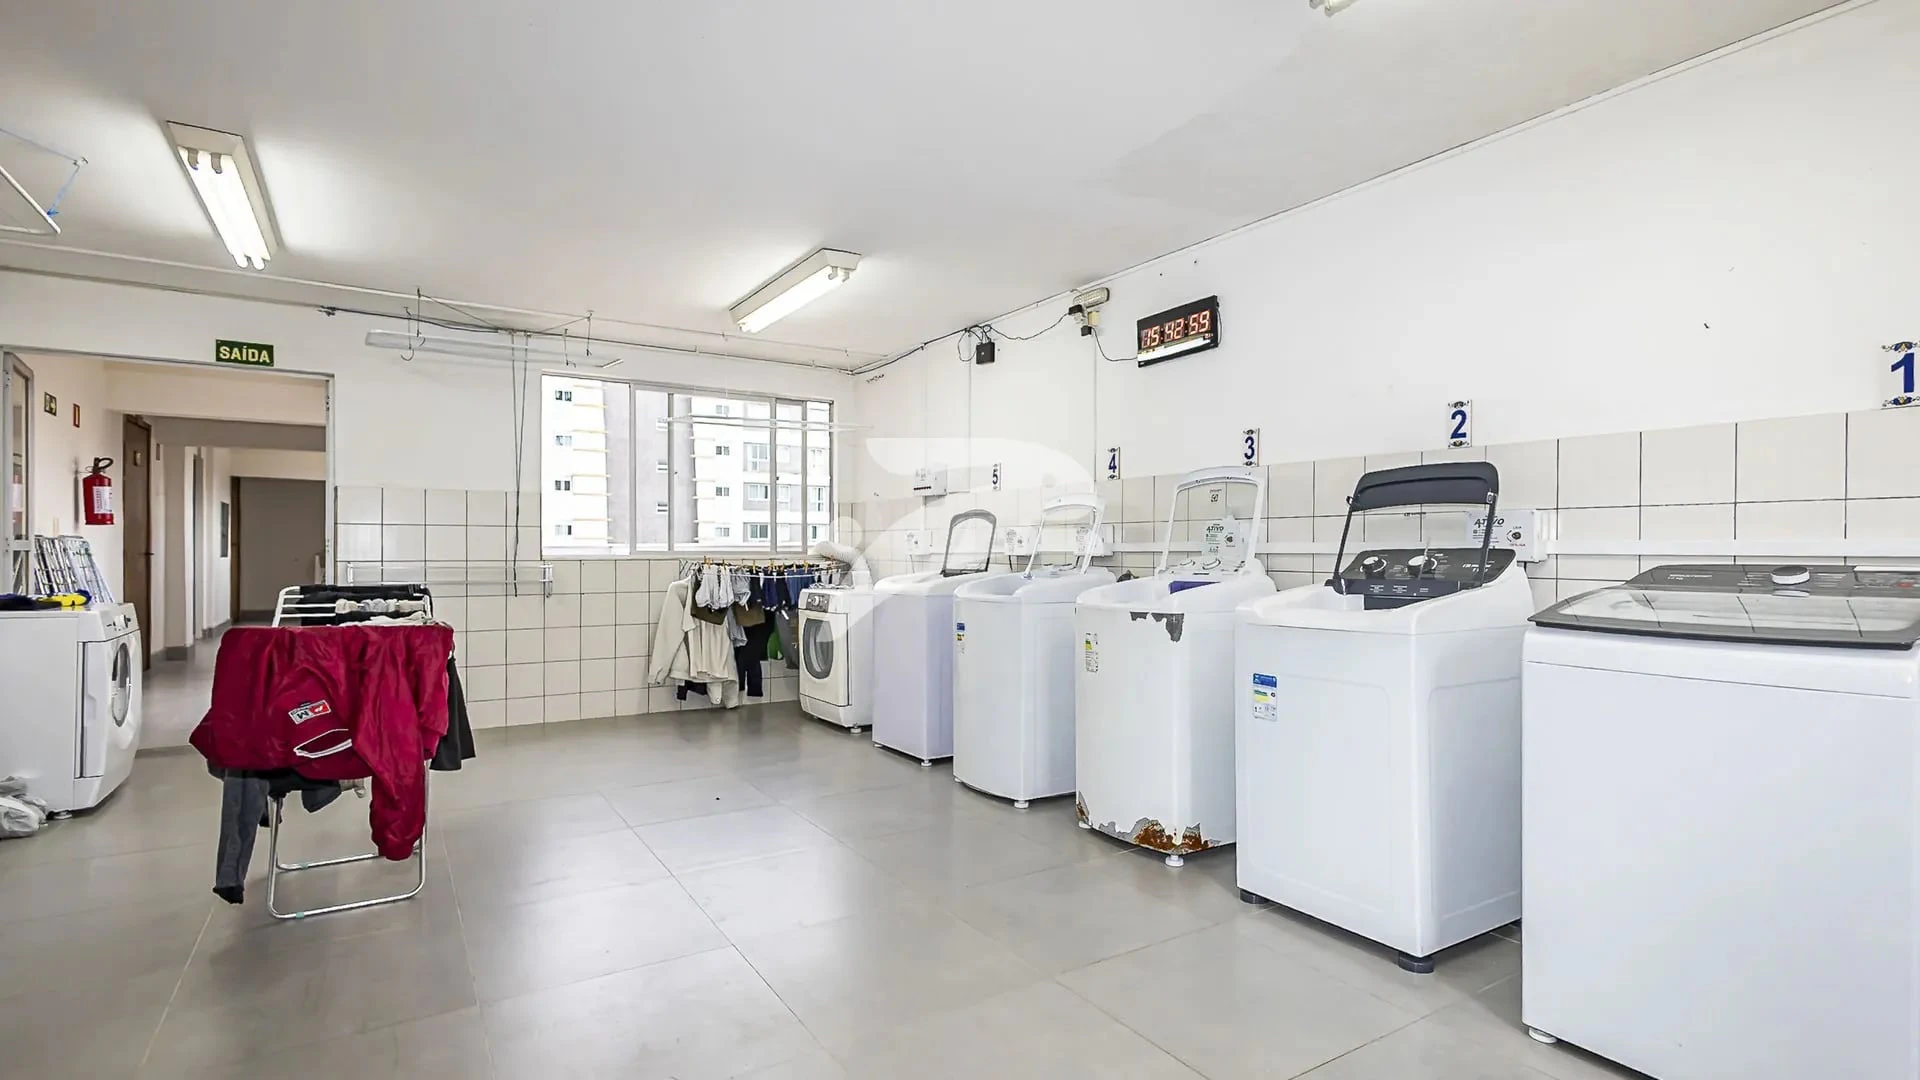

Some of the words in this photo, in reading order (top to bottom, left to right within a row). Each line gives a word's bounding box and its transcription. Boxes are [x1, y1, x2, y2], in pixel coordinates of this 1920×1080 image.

[1141, 309, 1211, 349] 15:42:59
[219, 345, 270, 363] SAÍDA
[1891, 352, 1915, 393] 1
[1450, 409, 1467, 440] 2
[1244, 436, 1255, 460] 3
[1108, 453, 1117, 473] 4
[992, 469, 999, 485] 5
